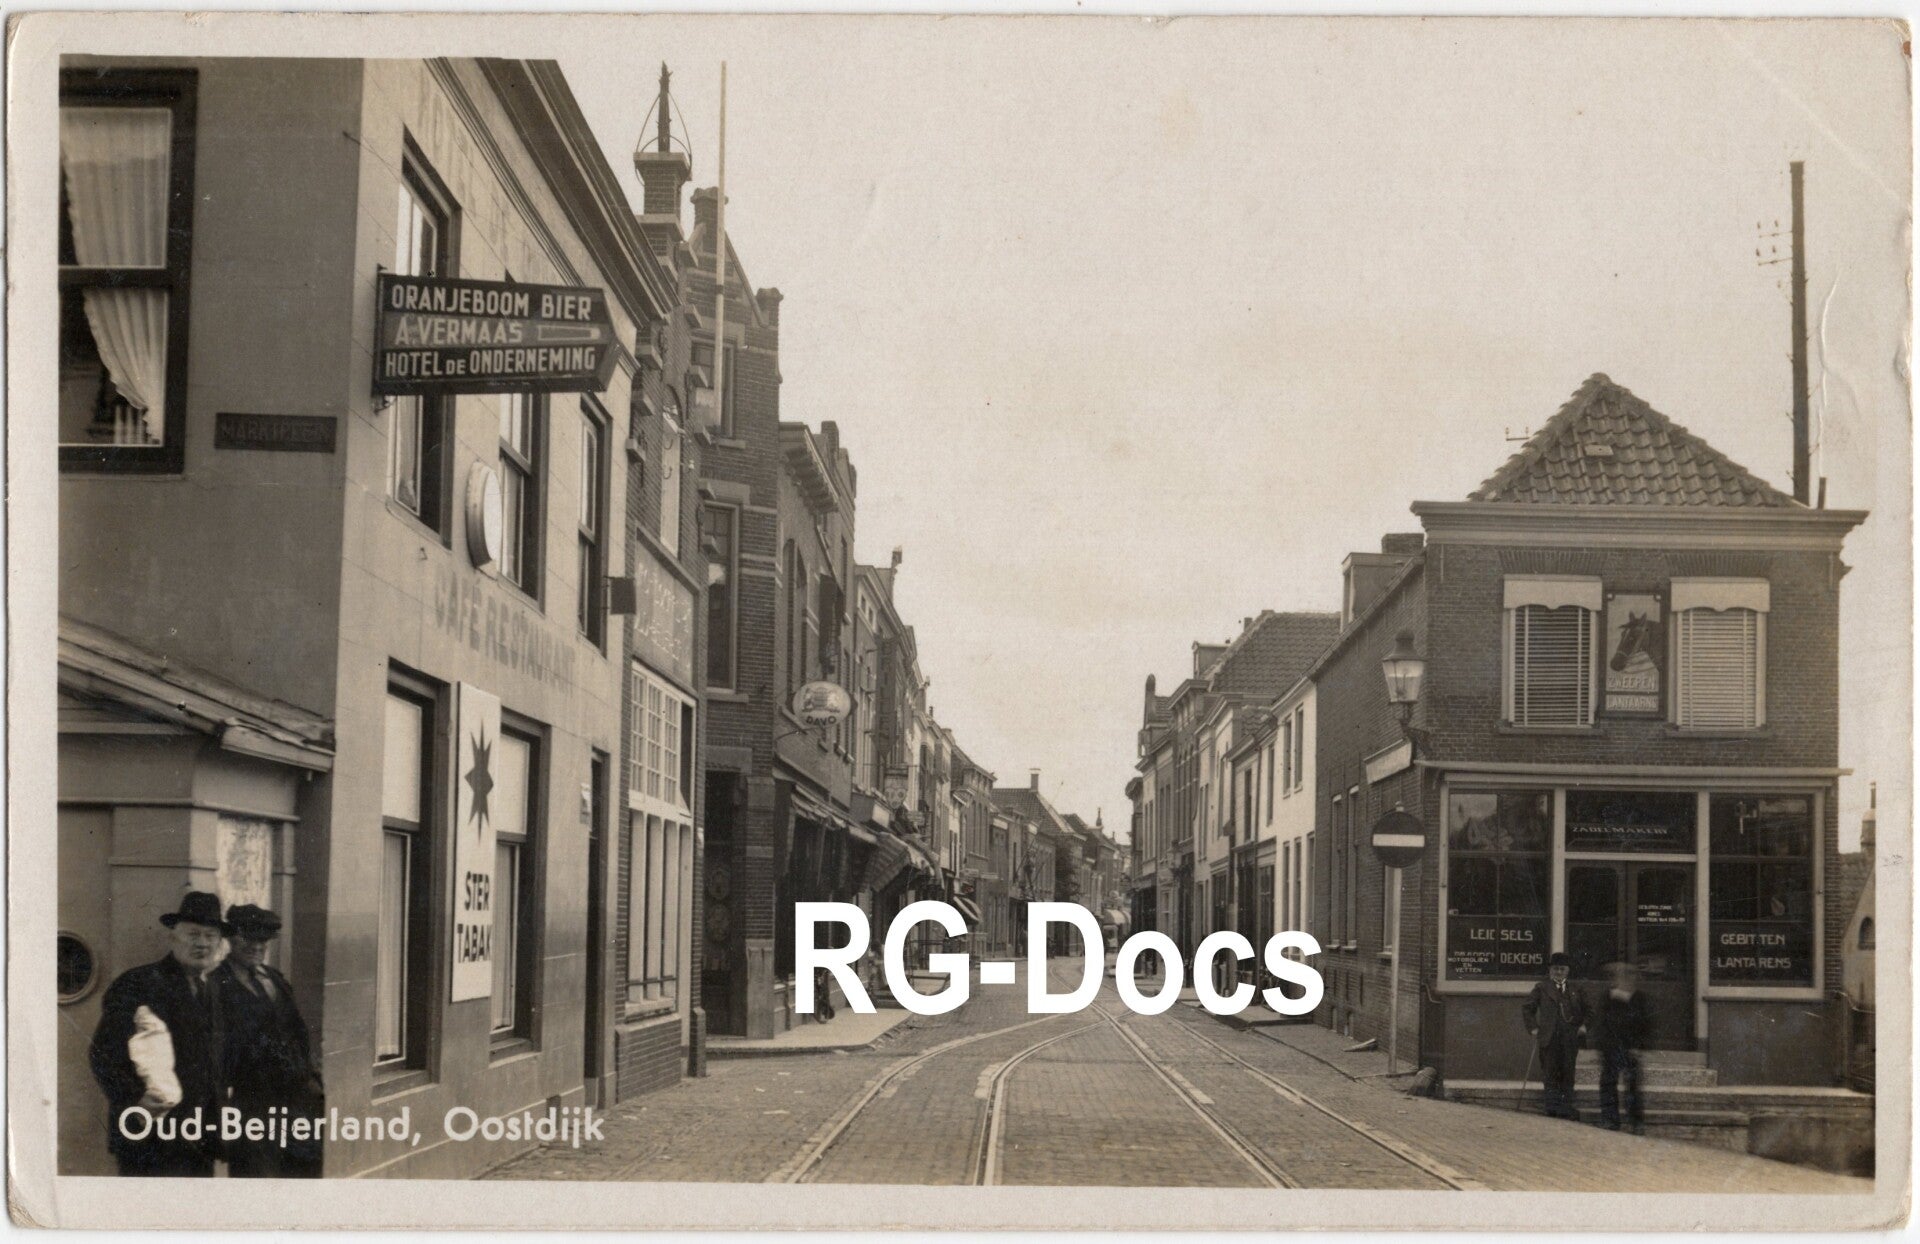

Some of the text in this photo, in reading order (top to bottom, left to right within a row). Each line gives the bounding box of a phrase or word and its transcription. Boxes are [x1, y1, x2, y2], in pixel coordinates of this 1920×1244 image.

[391, 284, 592, 321] ORANJEBOOM BIER
[385, 346, 596, 377] HOTEL DE ONDERNEMING
[464, 870, 490, 911] STER
[457, 923, 492, 963] TABAK
[1500, 952, 1543, 965] DEKENS
